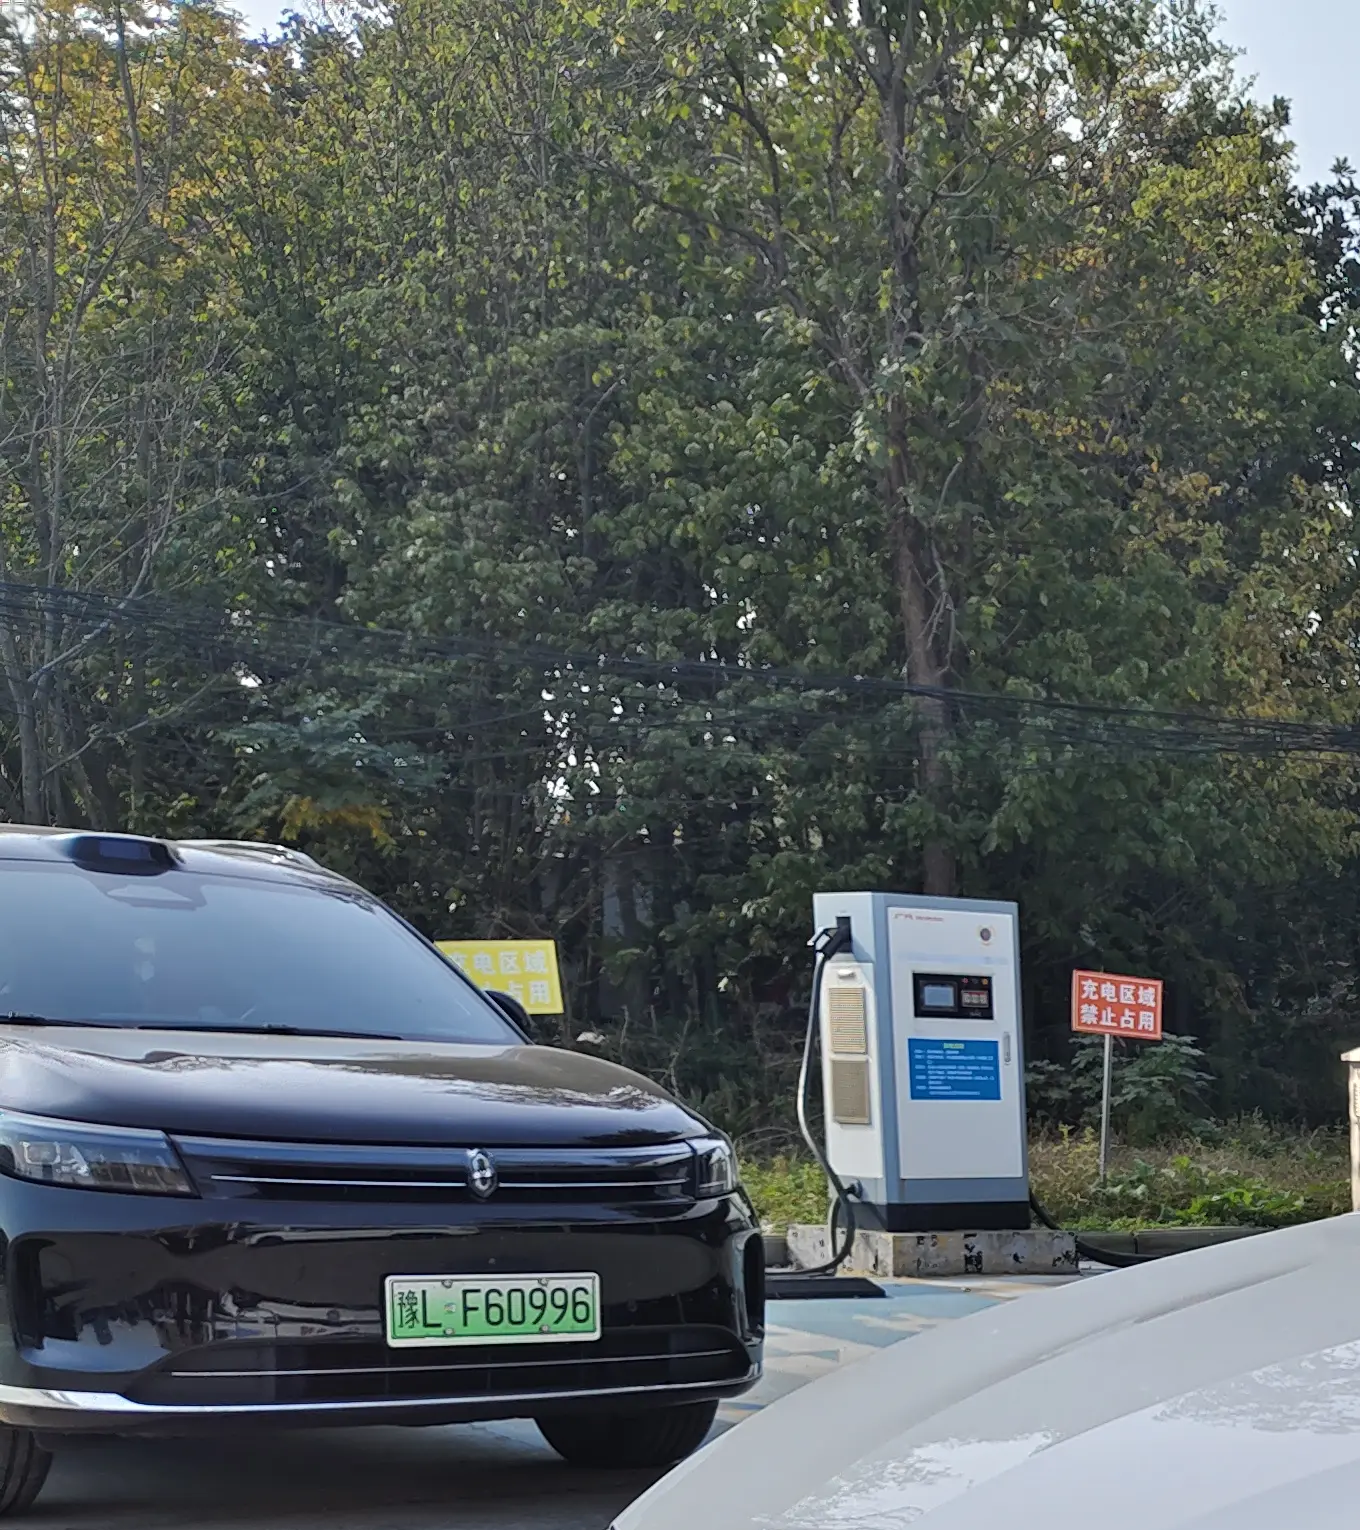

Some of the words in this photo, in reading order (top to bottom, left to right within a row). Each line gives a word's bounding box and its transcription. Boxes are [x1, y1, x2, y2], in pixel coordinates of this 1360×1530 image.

[1080, 979, 1156, 1007] 充电区域
[1080, 1003, 1155, 1031] 禁止占用
